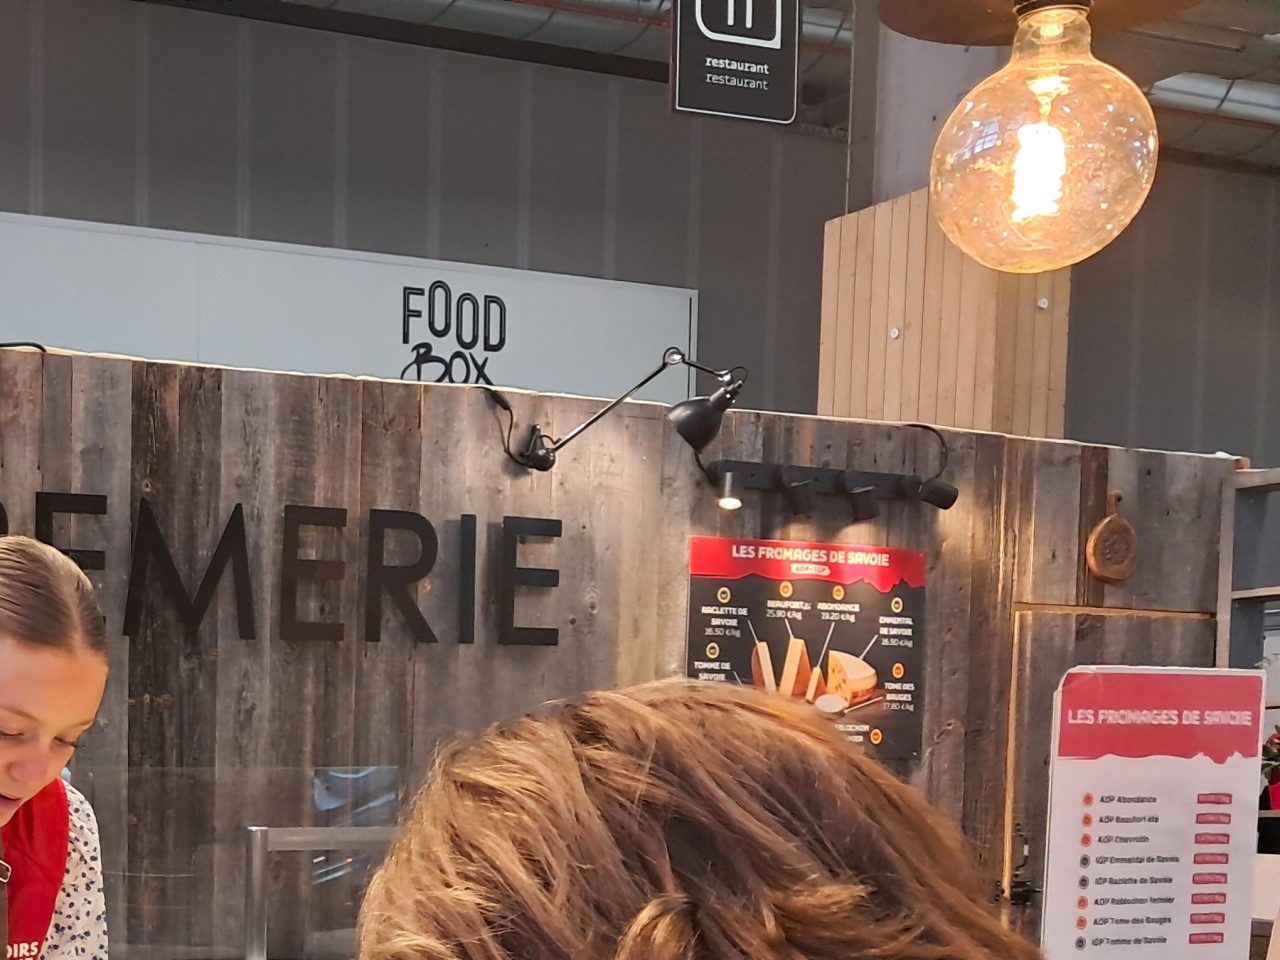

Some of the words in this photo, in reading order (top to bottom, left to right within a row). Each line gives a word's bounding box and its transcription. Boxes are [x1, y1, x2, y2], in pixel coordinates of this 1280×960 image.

[705, 56, 770, 75] restaurant
[705, 72, 768, 90] restaurant
[402, 280, 507, 352] FOOD
[732, 544, 756, 558] LES
[758, 546, 827, 562] FROMAGES
[829, 550, 846, 563] DE
[848, 551, 890, 567] SAVOIE
[1068, 709, 1095, 725] LES
[1098, 709, 1179, 725] FROMAGES
[1182, 710, 1201, 725] DE
[1203, 710, 1252, 726] SAVOIE
